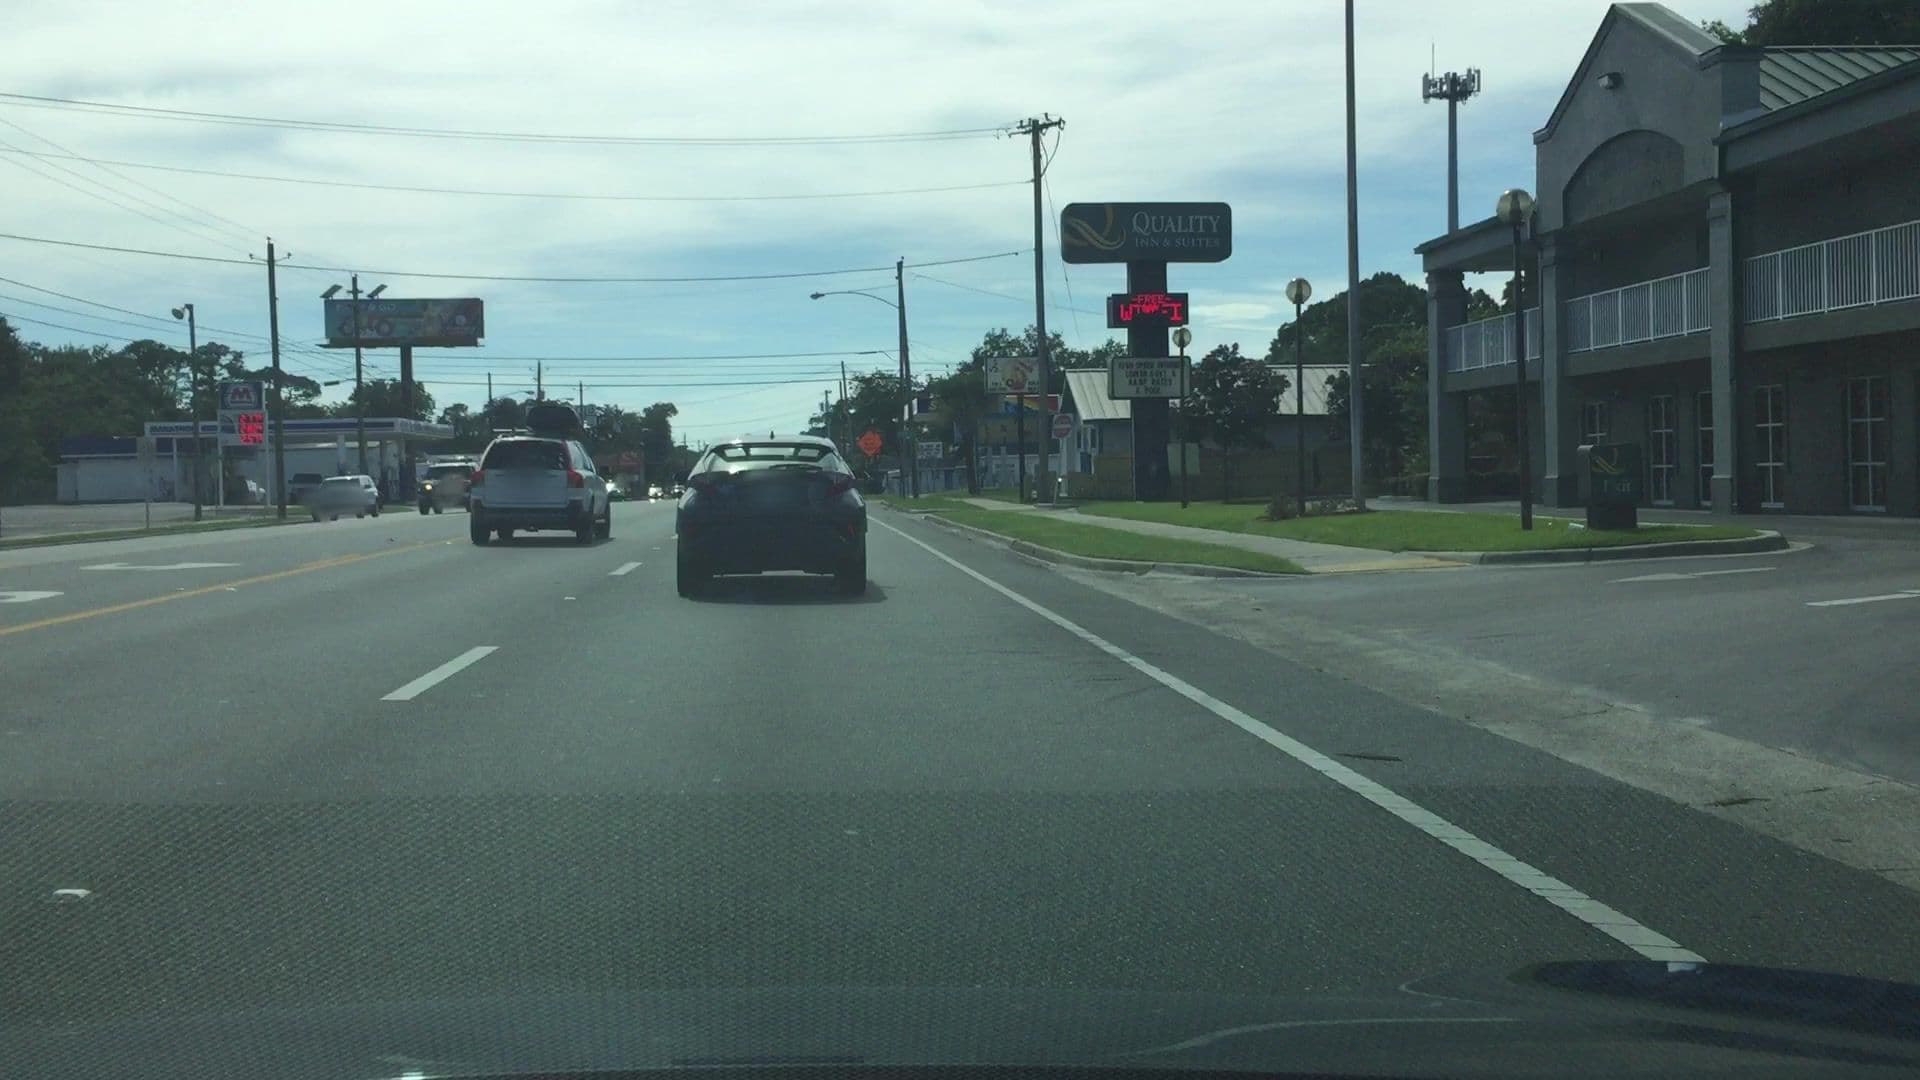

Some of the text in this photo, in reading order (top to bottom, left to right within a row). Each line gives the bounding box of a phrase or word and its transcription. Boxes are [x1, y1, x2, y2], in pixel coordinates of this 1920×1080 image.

[1132, 211, 1220, 235] QUALITY
[1135, 238, 1220, 248] INN & SUITES
